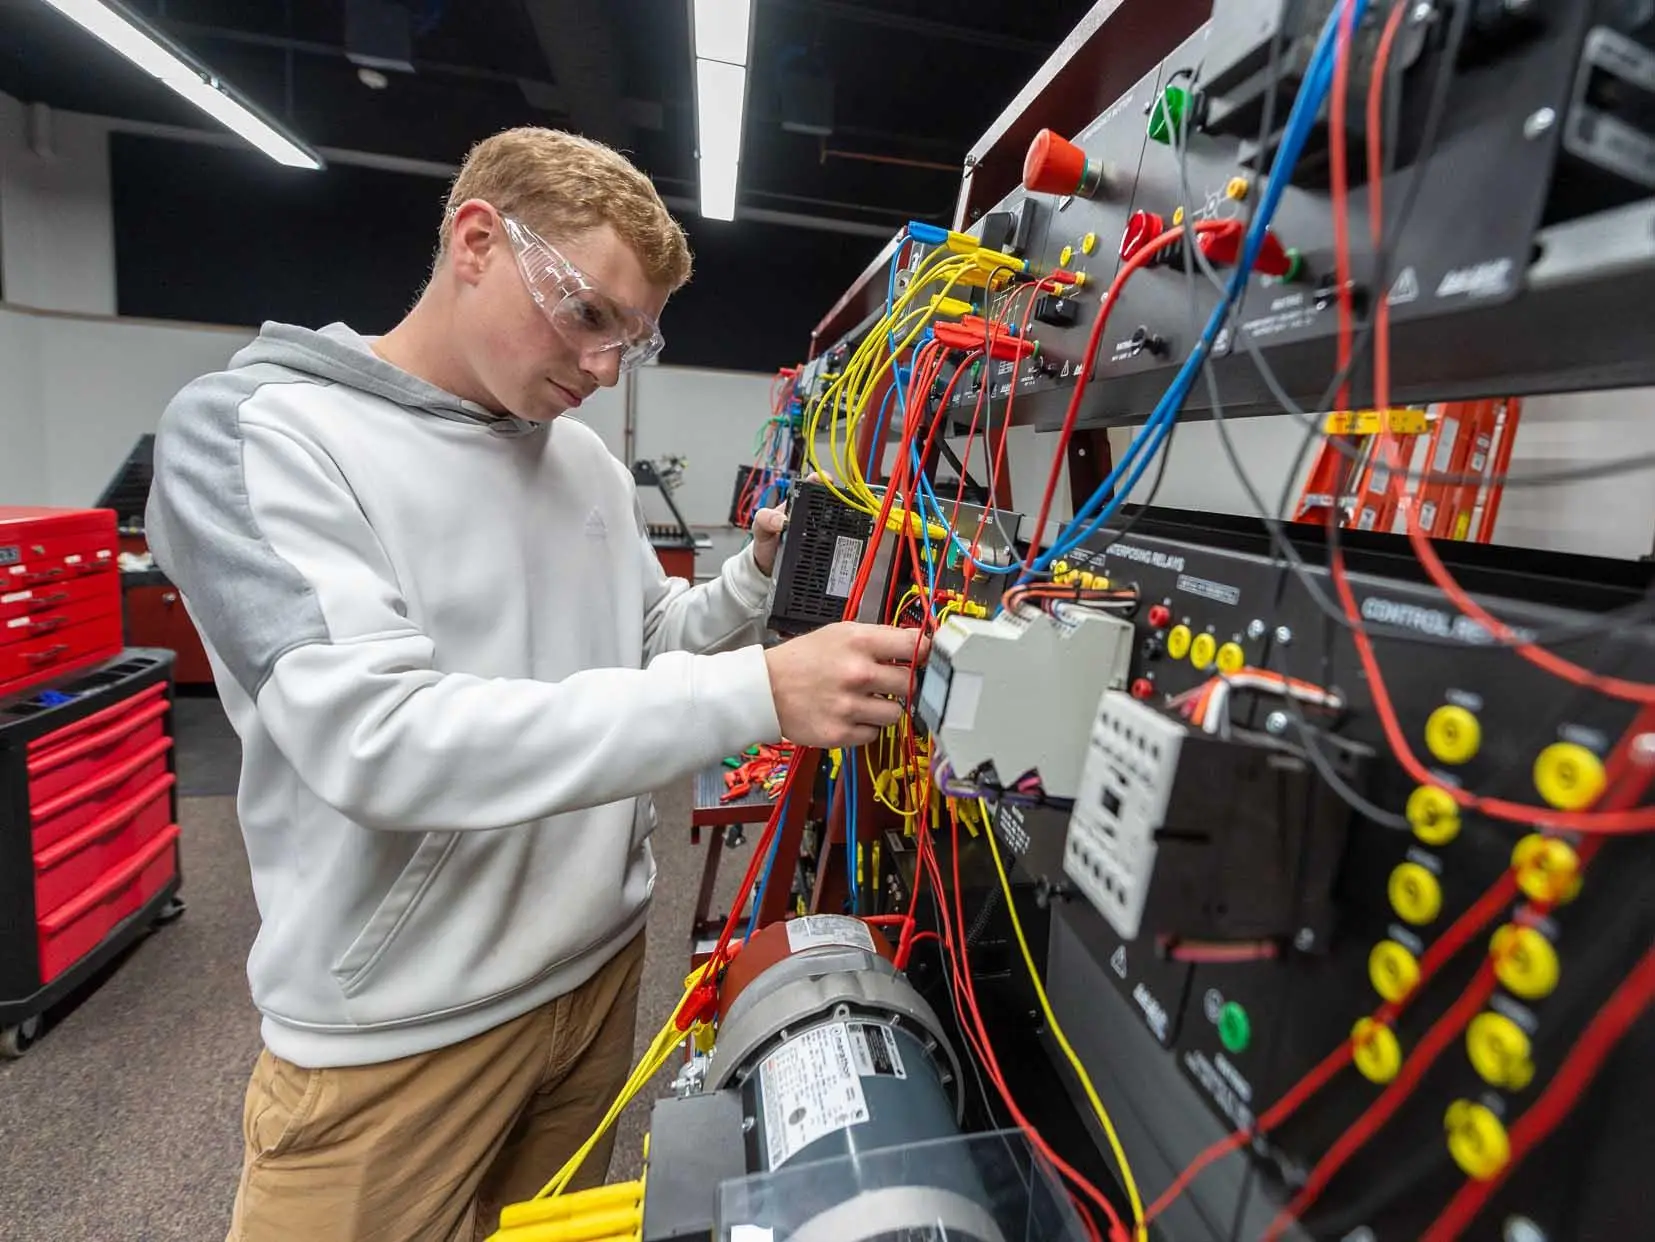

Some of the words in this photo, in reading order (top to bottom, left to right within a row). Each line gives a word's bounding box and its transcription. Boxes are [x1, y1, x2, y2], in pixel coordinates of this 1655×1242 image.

[1152, 552, 1185, 572] RELAYS
[1362, 598, 1450, 638] CONTROL
[835, 1036, 851, 1078] marathon
